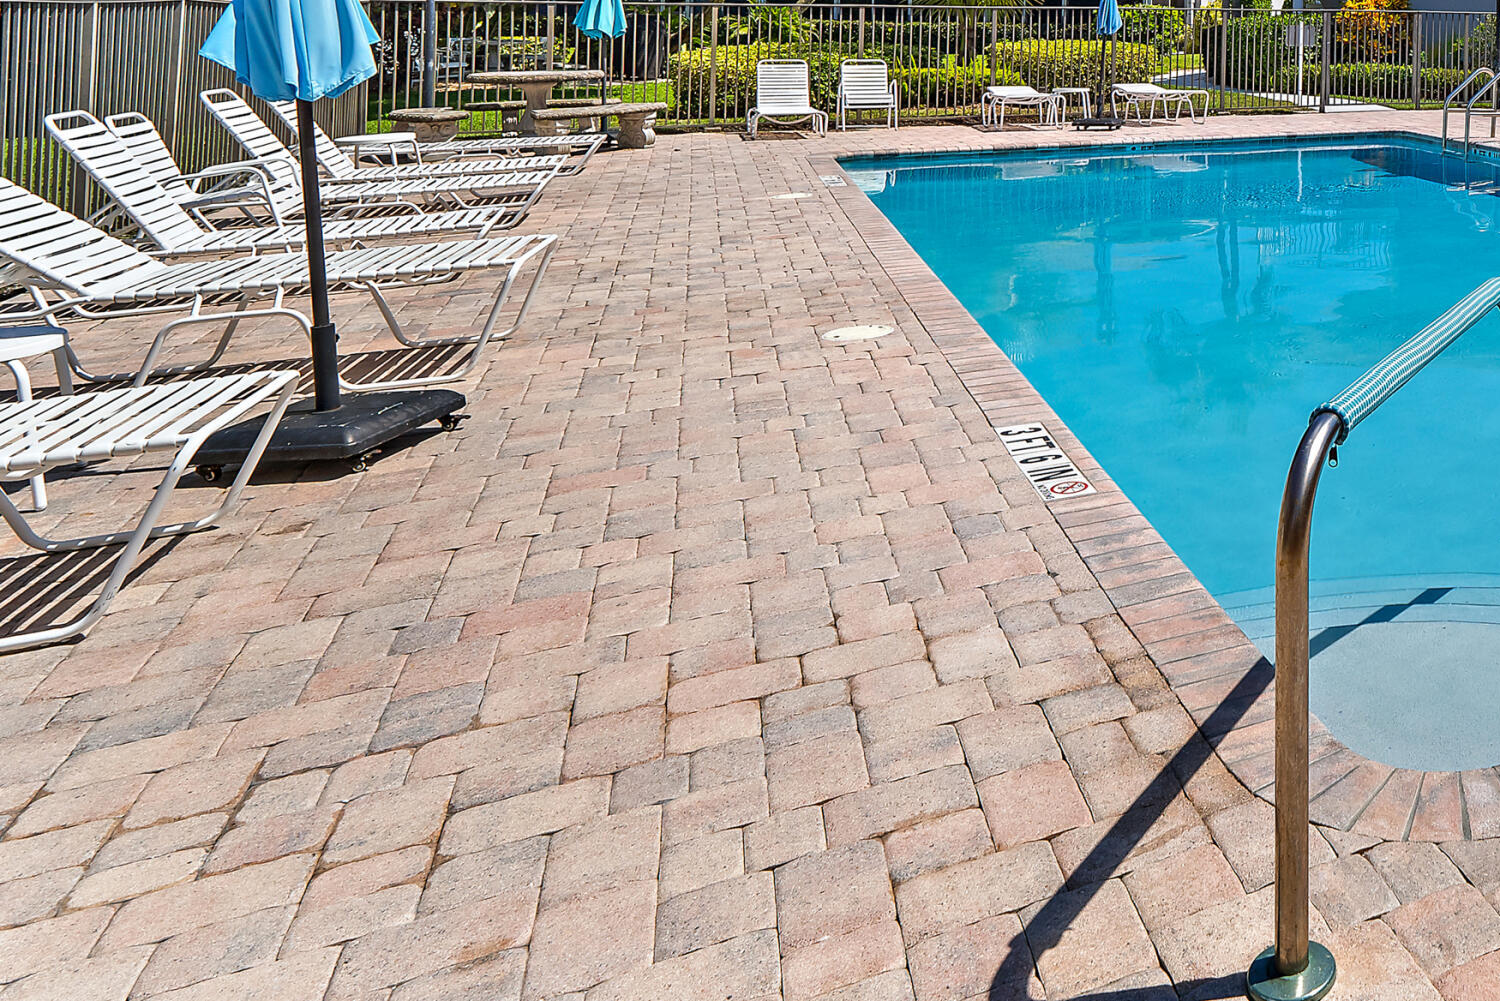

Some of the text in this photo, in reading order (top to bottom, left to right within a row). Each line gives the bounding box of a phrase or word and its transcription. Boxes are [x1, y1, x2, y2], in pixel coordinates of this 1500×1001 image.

[999, 427, 1078, 483] 3 FT 6 IN
